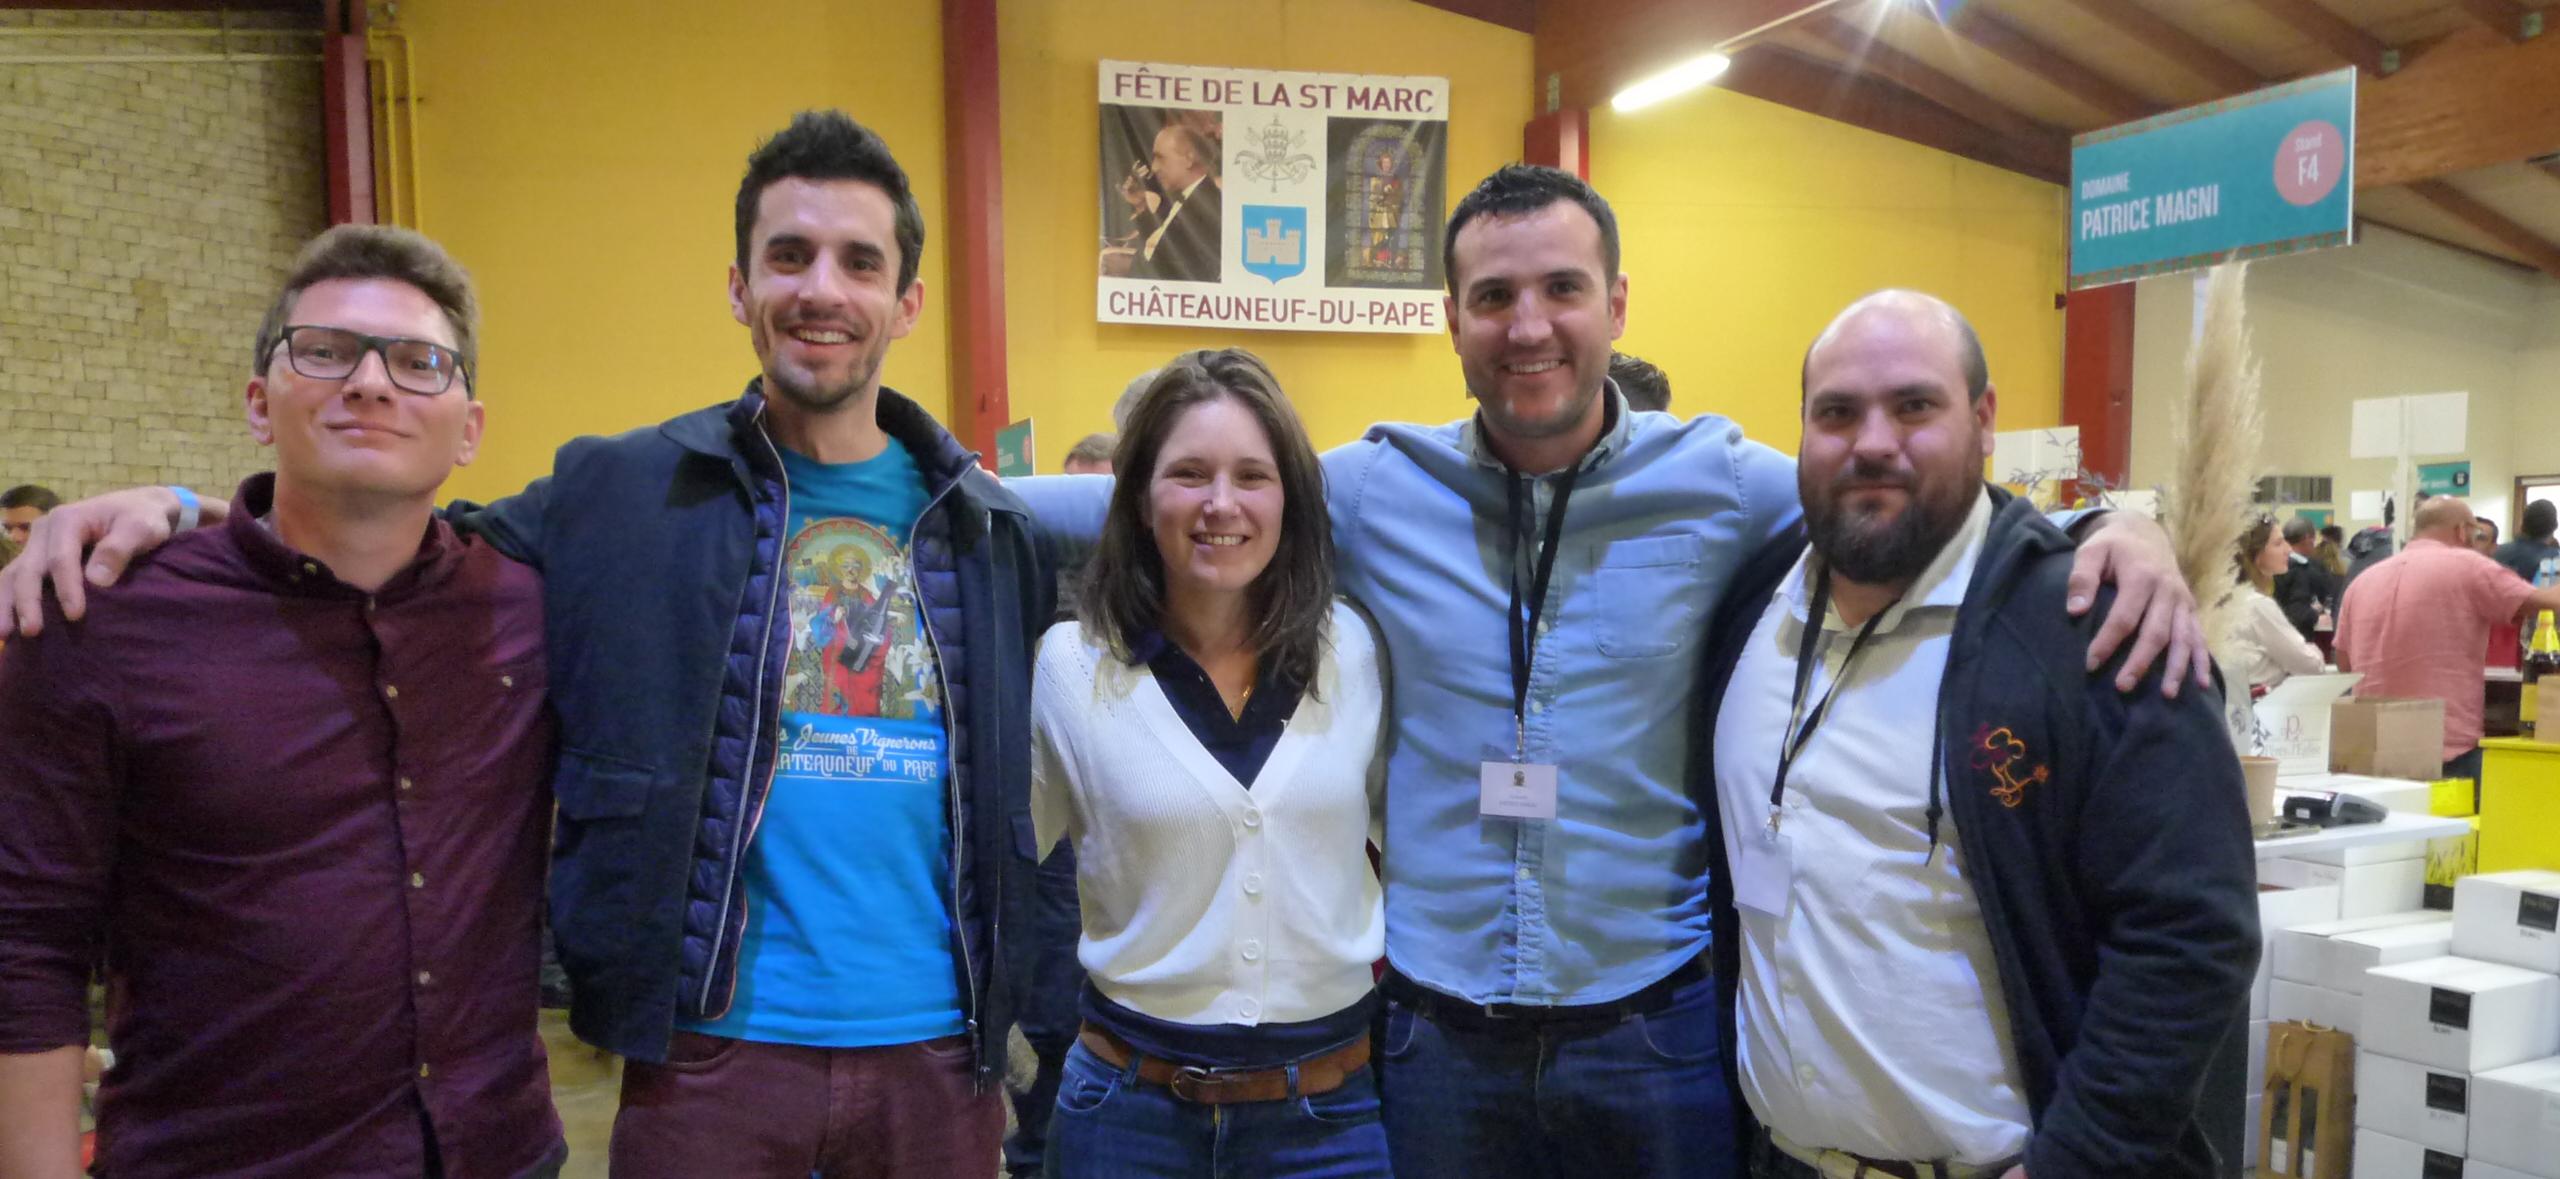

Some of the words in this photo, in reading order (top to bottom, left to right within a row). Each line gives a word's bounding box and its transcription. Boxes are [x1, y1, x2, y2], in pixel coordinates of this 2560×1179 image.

[1115, 67, 1192, 102] FÊTE
[1202, 79, 1243, 105] DE
[1253, 82, 1291, 107] LA
[1299, 85, 1337, 109] ST
[1347, 87, 1434, 112] MARC
[2081, 172, 2130, 199] DOMAINE
[2298, 153, 2319, 187] F4
[2081, 198, 2151, 240] PATRICE
[2156, 185, 2219, 226] MAGNI
[1109, 286, 1436, 327] CHÂTEAUNEUF-DU-PAPE
[794, 723, 857, 751] Jeunes
[855, 728, 937, 760] Vignerons
[776, 753, 876, 777] ATEAUNEUF
[882, 760, 897, 772] DU
[903, 759, 937, 781] PAPE
